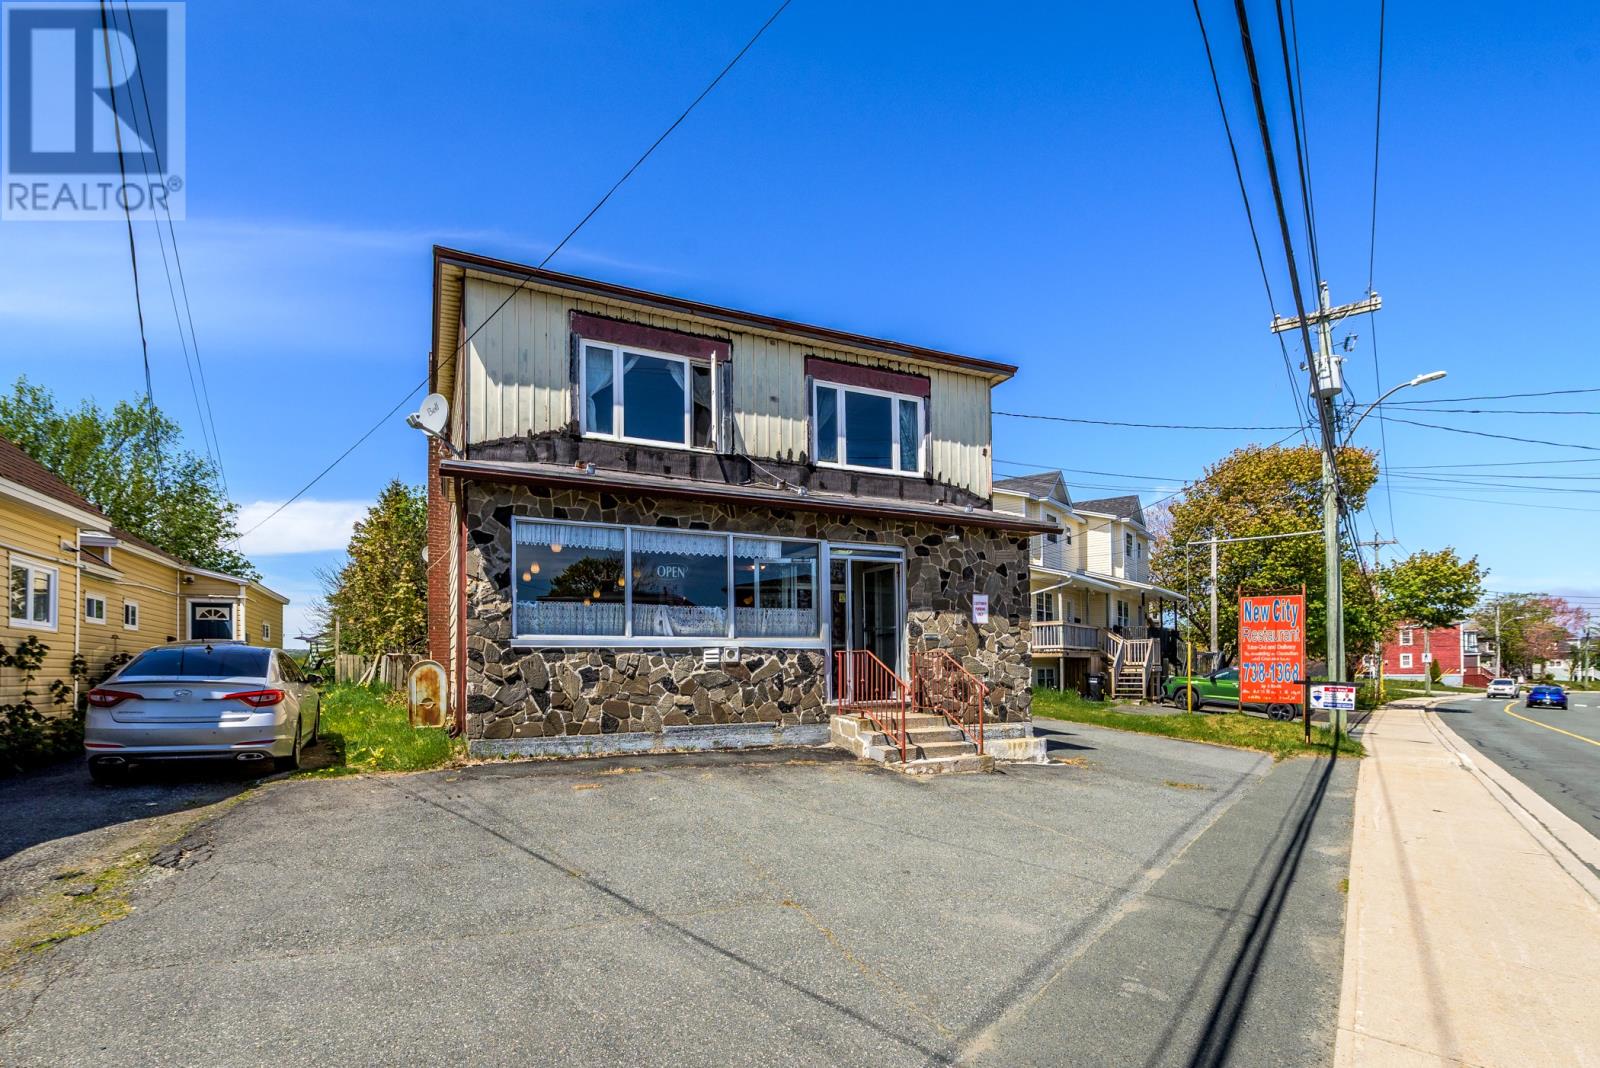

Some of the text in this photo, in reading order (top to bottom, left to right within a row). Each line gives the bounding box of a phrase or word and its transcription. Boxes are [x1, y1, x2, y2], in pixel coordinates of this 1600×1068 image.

[657, 565, 685, 578] OPEN
[1244, 599, 1298, 627] New City
[1243, 627, 1300, 642] Restaurant
[1243, 662, 1300, 683] 738-1368
